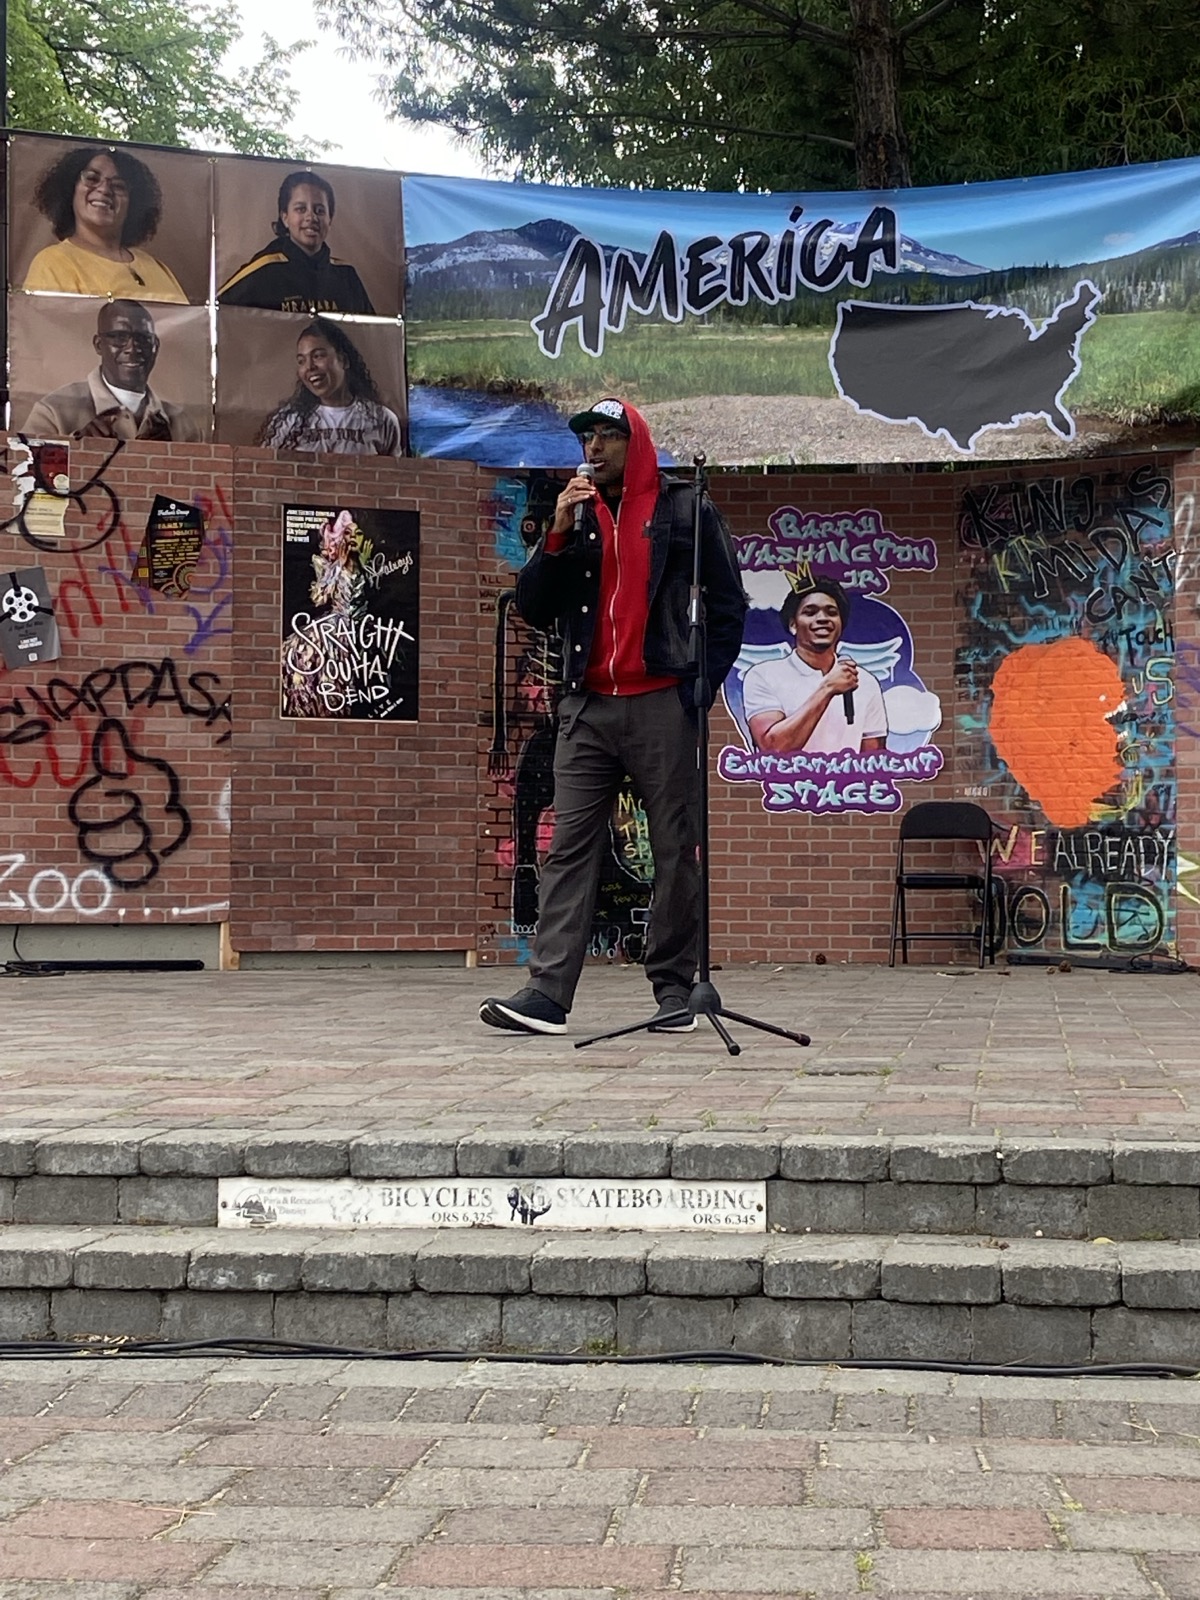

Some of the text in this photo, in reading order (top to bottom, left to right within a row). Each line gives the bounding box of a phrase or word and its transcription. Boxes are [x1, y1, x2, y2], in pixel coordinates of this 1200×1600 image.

[532, 203, 902, 361] AMERICA
[776, 508, 878, 540] BARRY
[736, 531, 931, 566] WASHINGTON
[839, 567, 883, 590] JR
[288, 612, 416, 675] STRAIGHT
[317, 682, 390, 712] BEND
[723, 749, 938, 778] ENTERTAINMENT
[767, 780, 896, 806] STAGE
[1053, 829, 1175, 880] ALREADY
[381, 1186, 756, 1210] BICYCLES SKATEBOARDING
[431, 1211, 493, 1223] ORS 6.325
[692, 1213, 756, 1225] ORS 6.345
